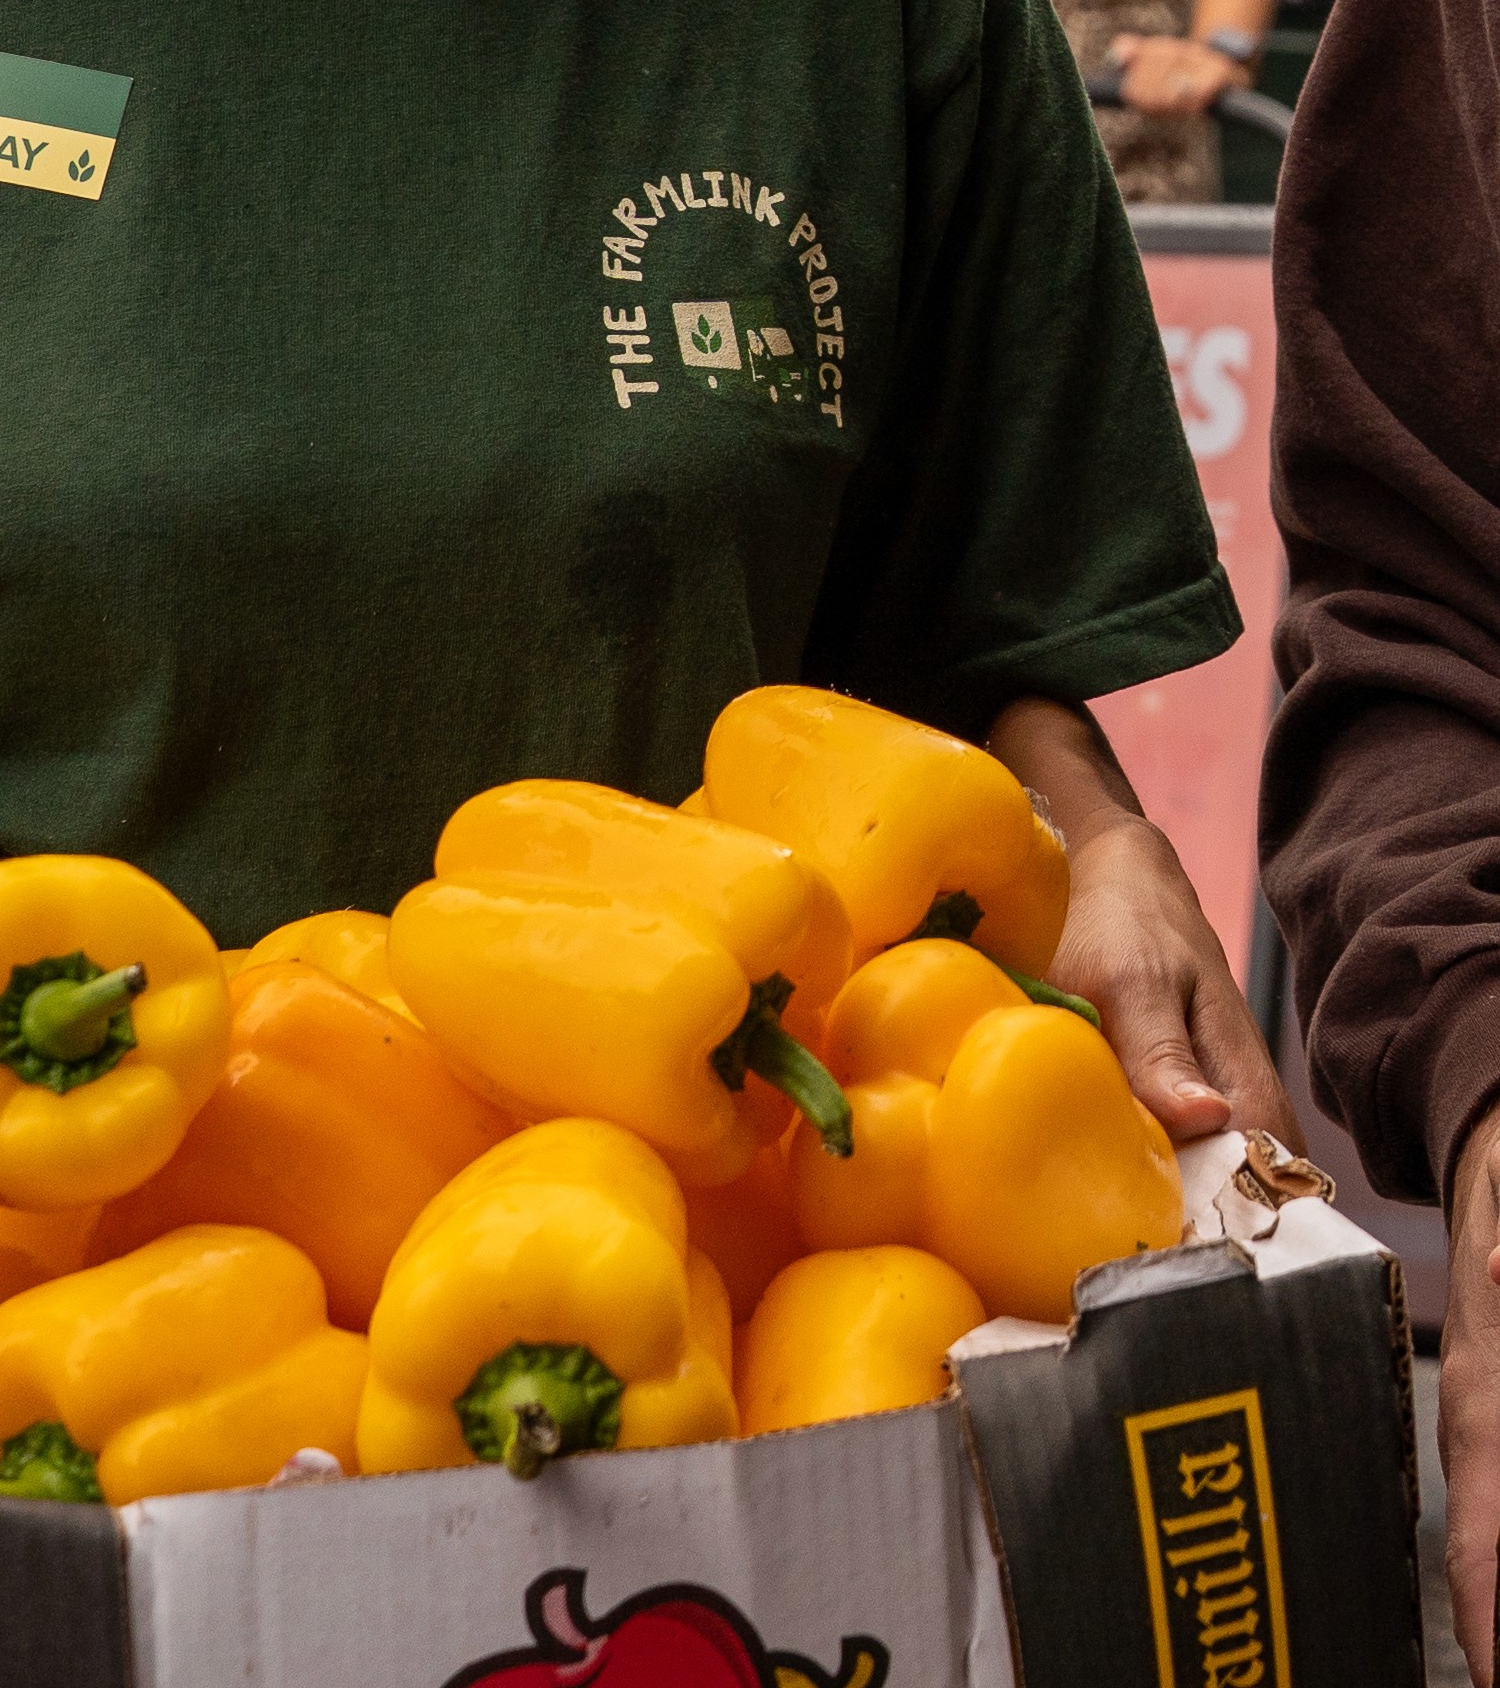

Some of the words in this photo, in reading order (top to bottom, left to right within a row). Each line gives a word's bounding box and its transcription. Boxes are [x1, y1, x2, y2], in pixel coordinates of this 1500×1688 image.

[602, 170, 786, 282] FARMLINK
[603, 305, 660, 410] THE
[788, 212, 846, 429] PROJECT
